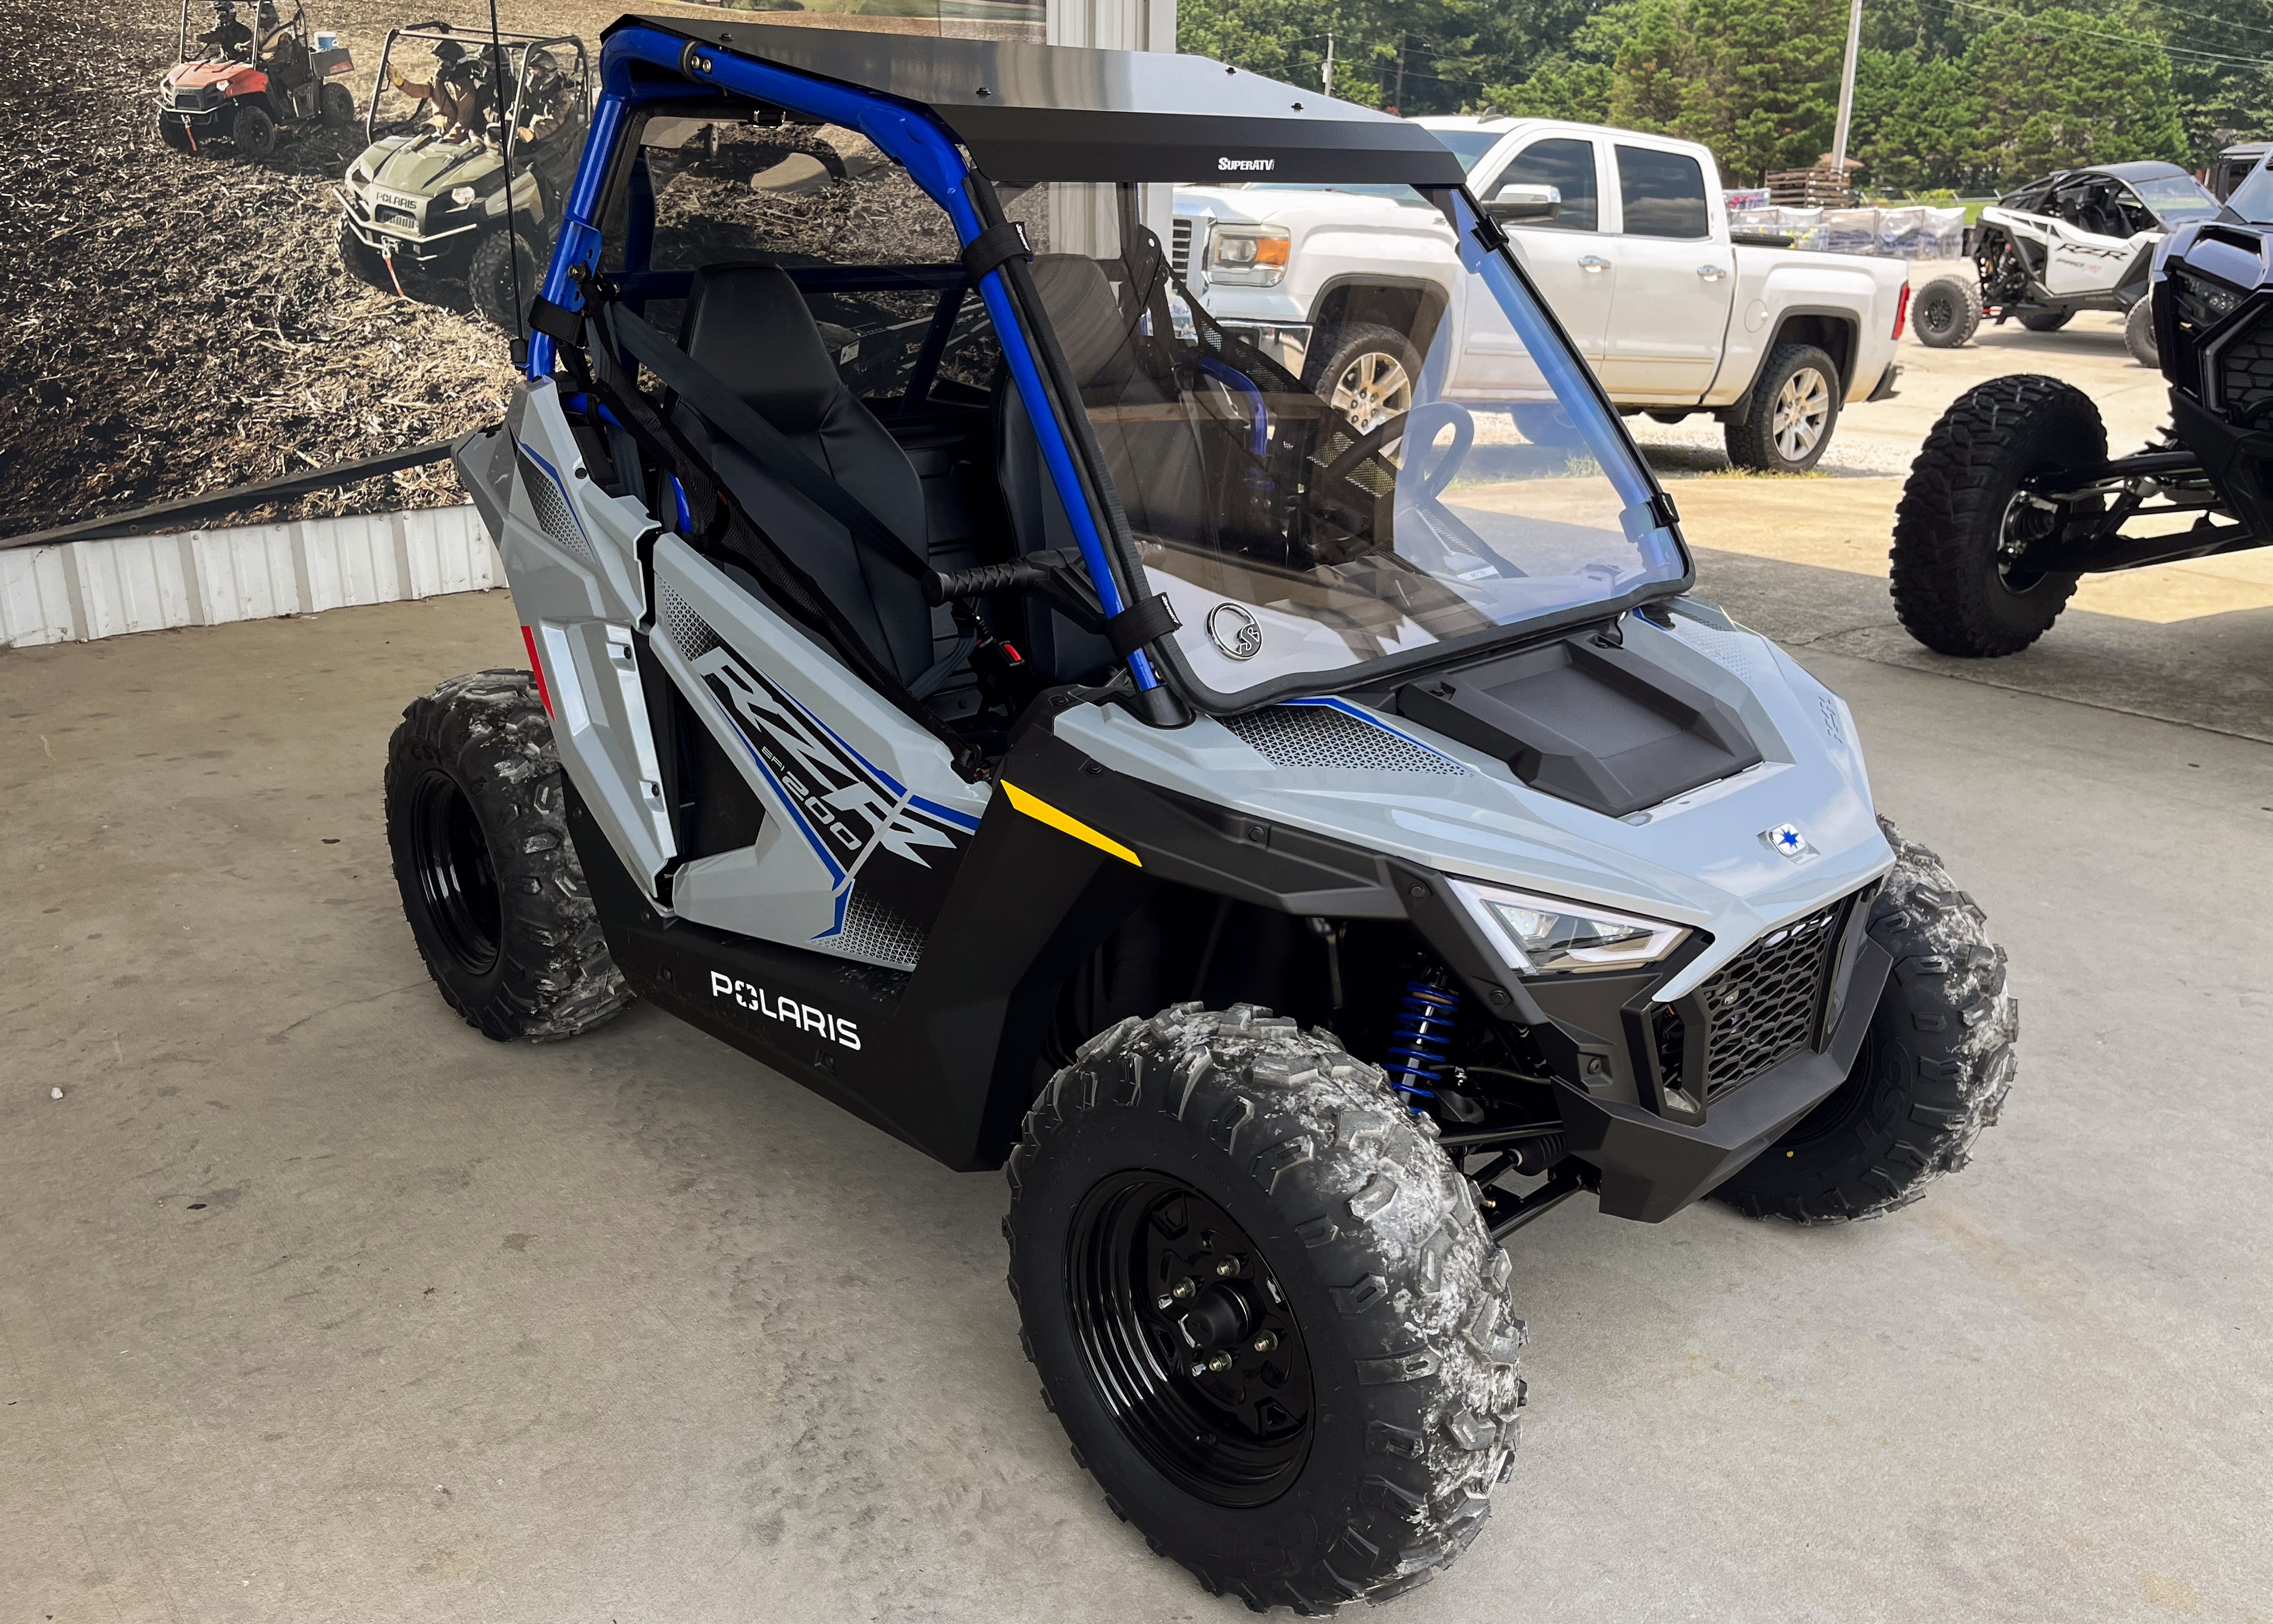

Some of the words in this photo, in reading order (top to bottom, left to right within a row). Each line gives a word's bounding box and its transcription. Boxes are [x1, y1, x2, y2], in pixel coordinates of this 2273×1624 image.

[377, 192, 418, 209] POLARIS
[2055, 243, 2128, 261] RZR
[690, 646, 957, 869] RZR
[761, 746, 785, 772] EFI
[782, 771, 862, 850] 200
[710, 971, 861, 1051] POLARIS
